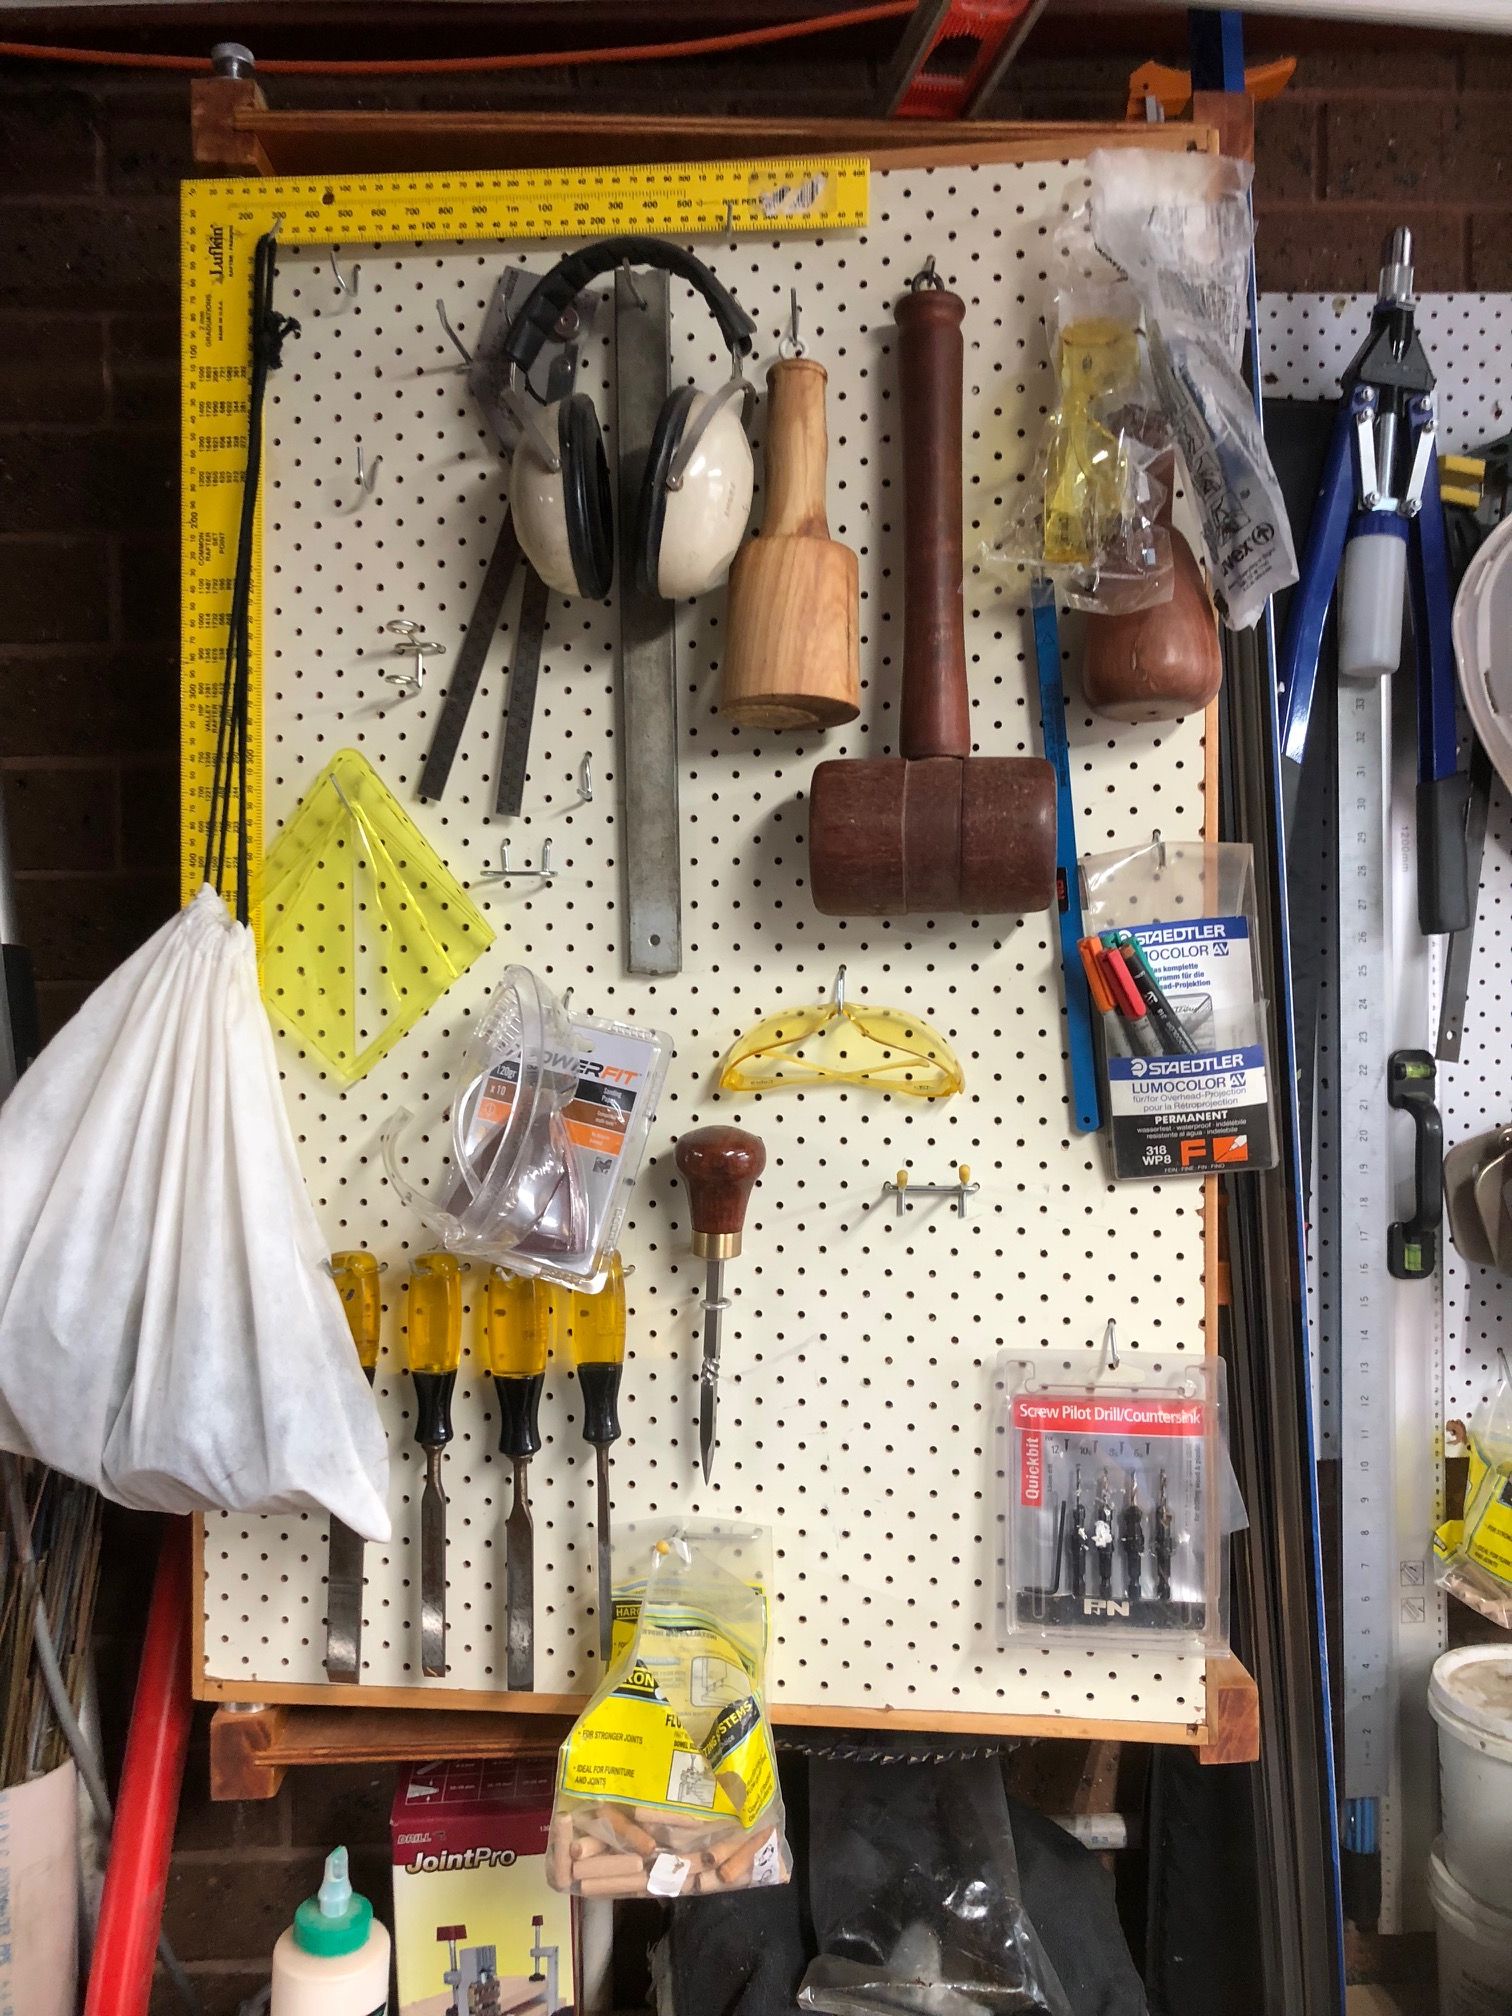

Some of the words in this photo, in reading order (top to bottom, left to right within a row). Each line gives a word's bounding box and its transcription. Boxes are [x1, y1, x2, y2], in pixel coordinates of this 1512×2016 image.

[305, 210, 320, 218] 400
[338, 209, 353, 218] 500
[405, 207, 420, 216] 700
[438, 206, 453, 215] 800
[538, 203, 553, 212] 100
[574, 202, 589, 211] 200
[608, 201, 624, 210] 300
[642, 200, 658, 209] 400
[677, 199, 692, 208] 500
[421, 221, 436, 230] 100
[590, 217, 606, 225] 200
[208, 226, 223, 276] Lufkin
[189, 345, 197, 359] 100
[1355, 698, 1365, 710] 33
[1356, 731, 1366, 744] 32
[1356, 766, 1366, 777] 31
[1356, 798, 1366, 810] 30
[1356, 831, 1367, 844] 29
[189, 853, 197, 868] 400
[1357, 865, 1367, 877] 28
[1357, 899, 1367, 911] 27
[1134, 924, 1226, 946] STAEDTLER
[1357, 931, 1367, 943] 26
[1163, 962, 1199, 974] komplette
[1358, 965, 1367, 977] 25
[1181, 972, 1192, 980] für
[1358, 998, 1367, 1010] 24
[1358, 1031, 1368, 1043] 23
[543, 1051, 639, 1086] OWERFIT
[1148, 1053, 1244, 1076] STAEDTLER
[1358, 1064, 1368, 1076] 22
[496, 1065, 517, 1080] 120gr
[497, 1084, 507, 1096] 10
[1132, 1077, 1226, 1094] LUMOCOLOR
[1160, 1087, 1247, 1102] Overhead-Projection
[1143, 1103, 1162, 1113] pour
[1164, 1102, 1172, 1110] la
[1173, 1097, 1238, 1110] Rétroprojection
[1359, 1099, 1368, 1110] 21
[1155, 1110, 1228, 1125] PERMANENT
[1136, 1125, 1171, 1134] wasserfest
[1176, 1122, 1212, 1132] waterproof
[1146, 1131, 1178, 1139] resistente
[1185, 1130, 1203, 1138] agua
[1359, 1129, 1368, 1142] 20
[1145, 1145, 1167, 1156] 318
[1180, 1139, 1207, 1167] F
[1141, 1154, 1172, 1167] WP8
[1359, 1163, 1368, 1174] 19
[1359, 1196, 1369, 1208] 18
[1360, 1231, 1369, 1242] 17
[1360, 1263, 1369, 1274] 16
[1360, 1295, 1369, 1307] 15
[1360, 1329, 1369, 1341] 14
[1360, 1362, 1369, 1373] 13
[1360, 1395, 1369, 1407] 12
[1019, 1403, 1059, 1418] Screw
[1061, 1405, 1092, 1420] Pilot
[1094, 1407, 1201, 1424] Drill/Countersink
[1360, 1430, 1369, 1439] 11
[1025, 1437, 1039, 1500] Quickbit
[1360, 1461, 1369, 1472] 10
[665, 1713, 684, 1728] FLU
[582, 1730, 593, 1738] FOR
[594, 1730, 624, 1742] STRONGER
[623, 1734, 643, 1745] JOINTS
[576, 1764, 592, 1773] IDEAL
[592, 1765, 604, 1774] FOR
[604, 1766, 635, 1778] FURNITURE
[574, 1776, 587, 1784] AND
[587, 1777, 607, 1786] JOINTS
[397, 1833, 432, 1845] DRILL
[405, 1846, 516, 1874] JointPro
